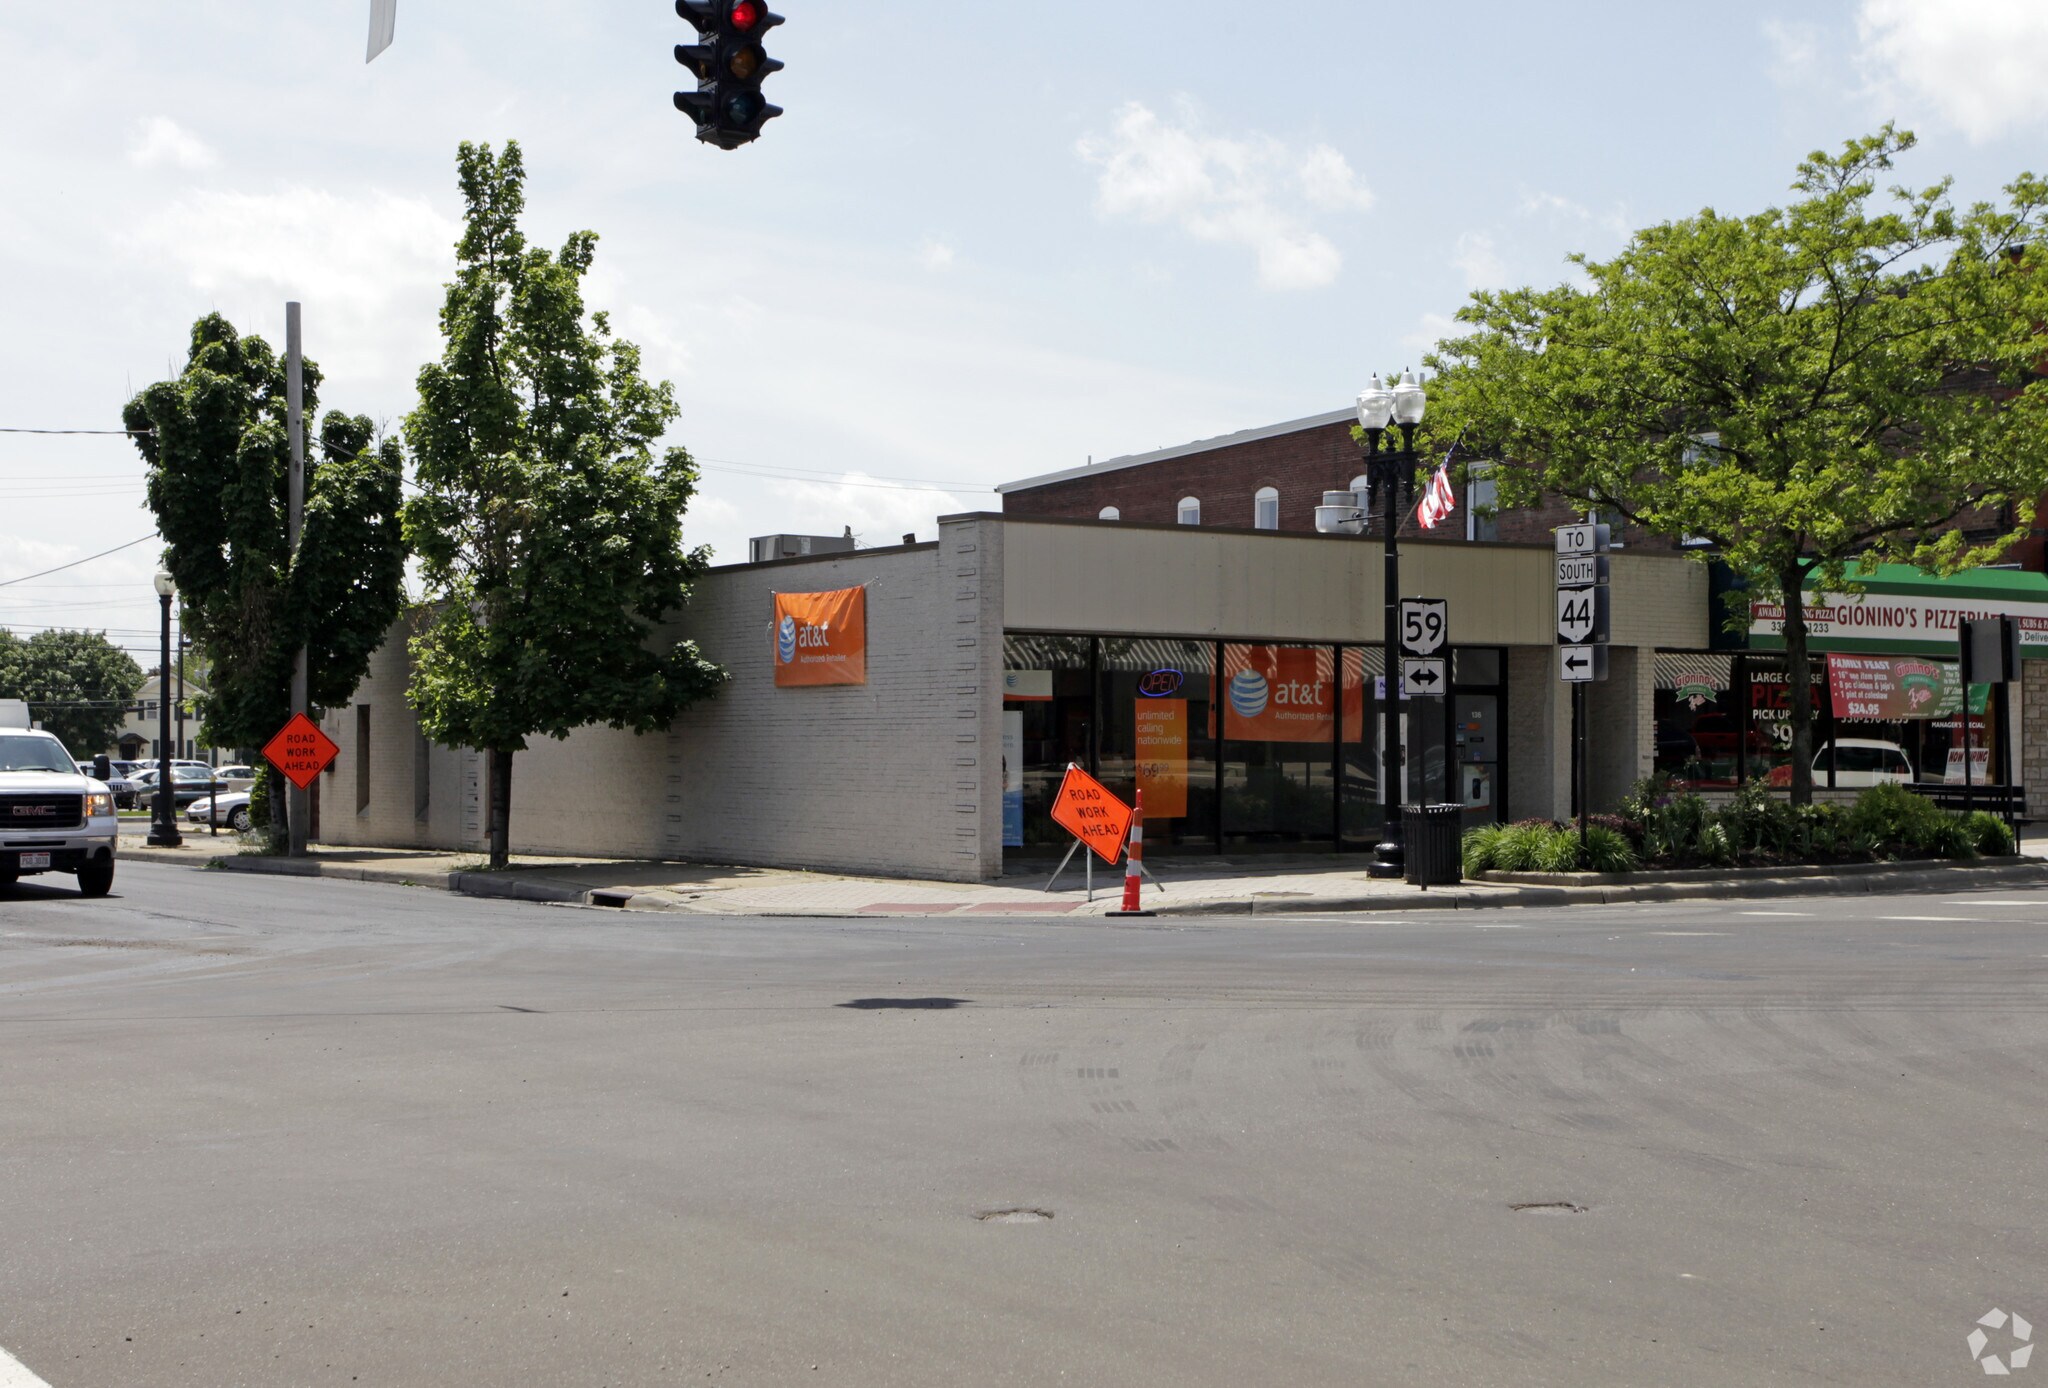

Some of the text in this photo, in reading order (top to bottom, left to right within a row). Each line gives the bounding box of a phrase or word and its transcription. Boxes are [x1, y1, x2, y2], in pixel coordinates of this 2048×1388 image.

[1566, 531, 1585, 547] TO
[1559, 563, 1594, 580] SOUTH
[1561, 598, 1591, 629] 44
[1757, 607, 1782, 617] AWARD
[1815, 609, 1835, 620] PIZZA
[1837, 605, 1918, 629] GIONINO'S
[1406, 611, 1442, 642] 59
[799, 621, 830, 647] at&t
[1831, 658, 1890, 670] FAMILY FEAST
[1141, 673, 1181, 692] OPEN
[1675, 673, 1716, 689] Gionino's
[1751, 672, 1782, 683] LARGE
[1275, 679, 1323, 705] at&t
[1752, 684, 1822, 708] PIZA
[1848, 701, 1880, 715] $24.95
[1137, 711, 1175, 720] unlimited
[1275, 711, 1315, 720] Authorized
[1752, 709, 1792, 720] PICK UP
[1137, 723, 1164, 734] calling
[1931, 721, 1962, 729] MANAGER'S
[286, 734, 316, 744] ROAD
[1137, 735, 1182, 745] nationwide
[286, 748, 316, 757] WORK
[284, 761, 320, 770] AHEAD
[1069, 789, 1101, 801] ROAD
[13, 805, 57, 816] GMC
[1076, 806, 1109, 819] WORK
[1082, 823, 1120, 837] AHEAD
